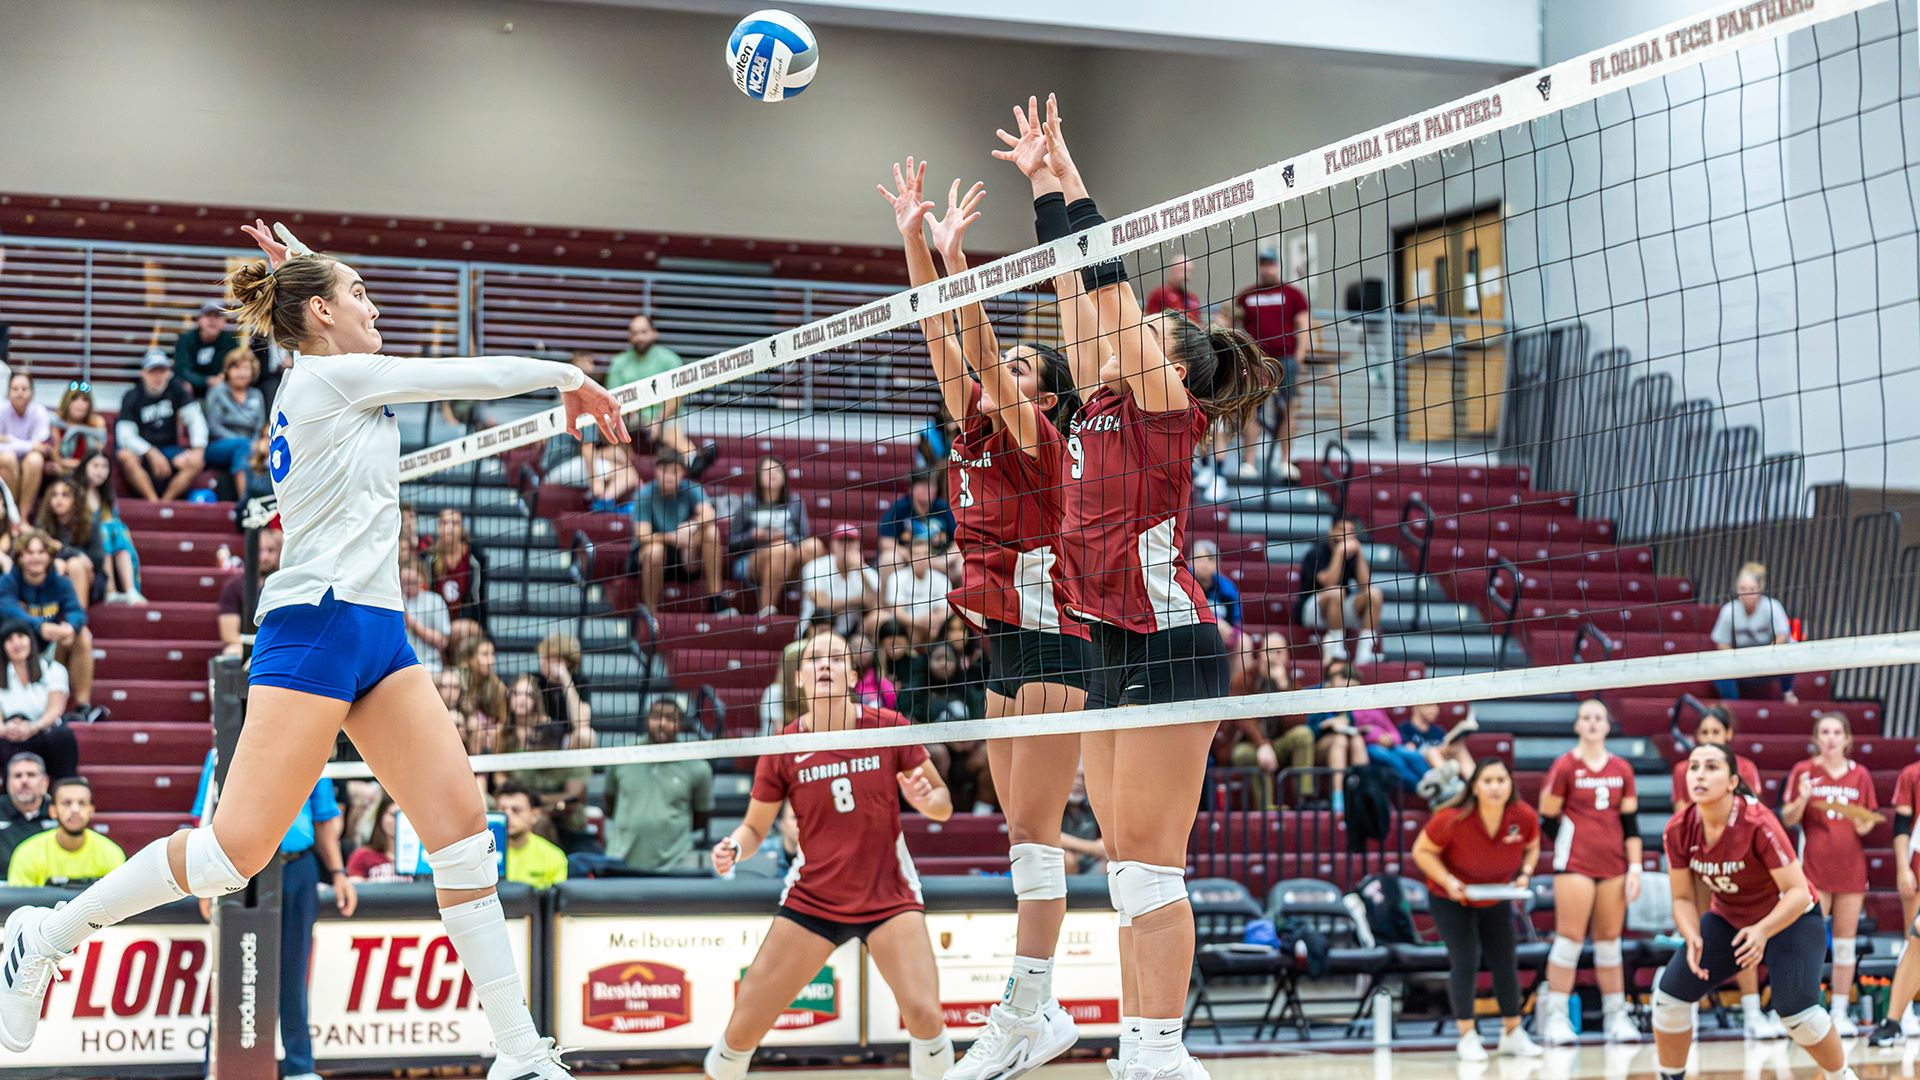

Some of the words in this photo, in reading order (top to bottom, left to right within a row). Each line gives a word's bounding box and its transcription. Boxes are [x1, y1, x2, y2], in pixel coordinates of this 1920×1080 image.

[736, 45, 754, 90] molten
[1590, 37, 1663, 84] FLORIDA
[1665, 19, 1713, 58] TECH
[748, 56, 769, 94] NCAA
[1324, 135, 1383, 175] FLORIDA
[1385, 121, 1422, 153] TECH
[1424, 93, 1502, 141] PANTHERS
[1111, 212, 1159, 246] FLORIDA
[1160, 201, 1190, 229] TECH
[1192, 179, 1254, 218] PANTHERS
[938, 272, 977, 303] FLORIDA
[978, 264, 1004, 289] TECH
[1004, 246, 1056, 281] PANTHERS
[793, 325, 825, 350] FLORIDA
[826, 317, 847, 339] TECH
[848, 303, 891, 333] PANTHERS
[671, 365, 698, 389] FLORIDA
[699, 359, 717, 379] TECH
[718, 348, 754, 374] PANTHERS
[1068, 434, 1085, 479] 9
[798, 761, 848, 784] FLORIDA
[850, 755, 880, 773] TECH
[831, 777, 856, 813] 8
[82, 1029, 174, 1052] HOME
[187, 1028, 209, 1049] O
[310, 1020, 460, 1047] PANTHERS
